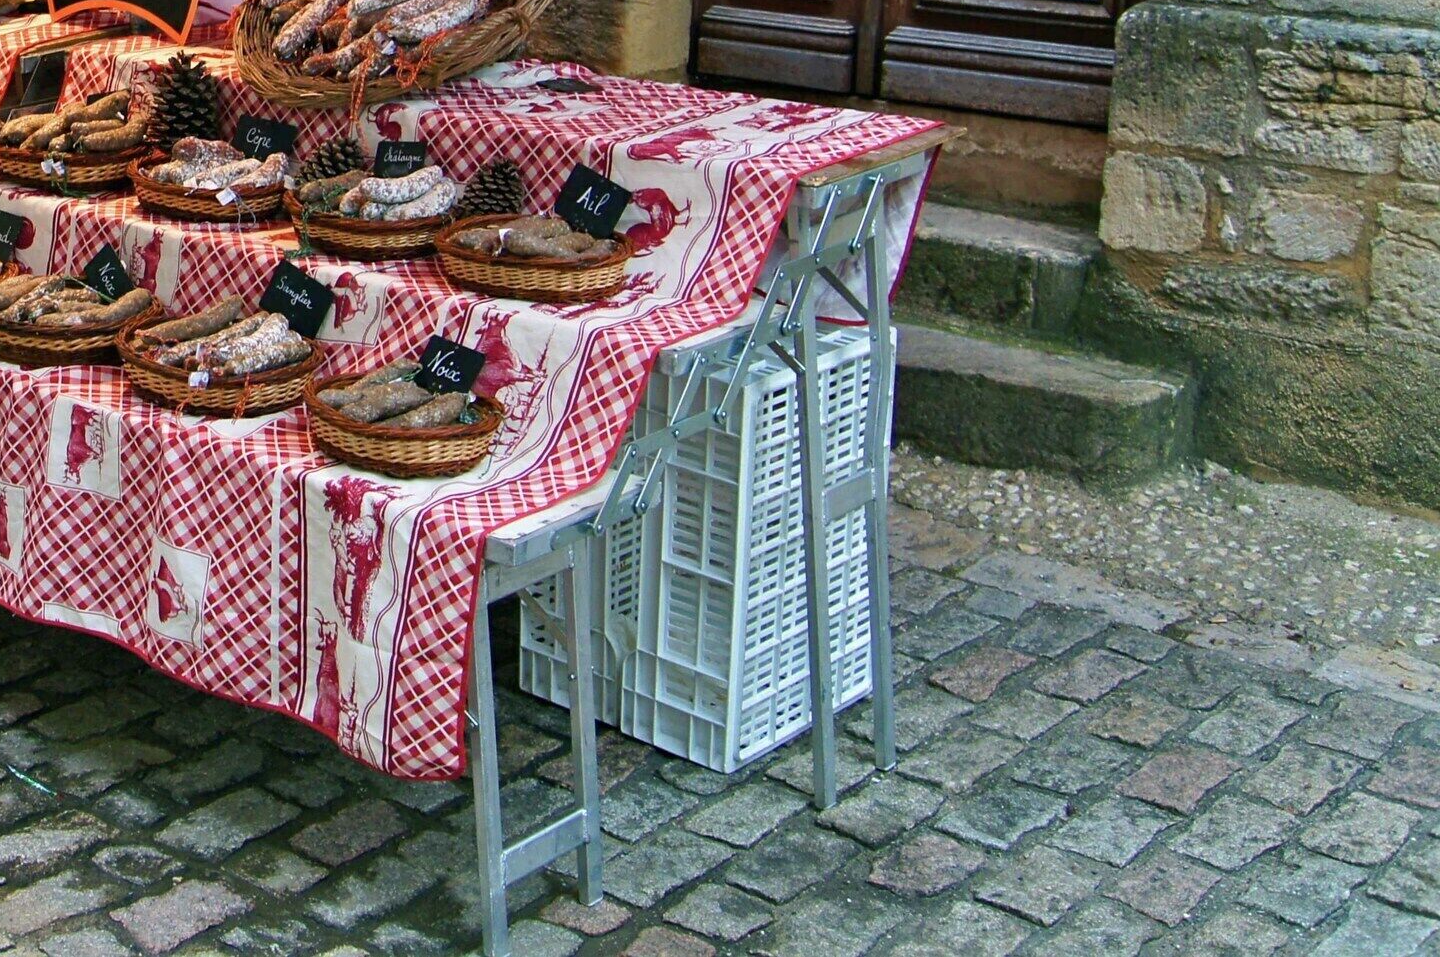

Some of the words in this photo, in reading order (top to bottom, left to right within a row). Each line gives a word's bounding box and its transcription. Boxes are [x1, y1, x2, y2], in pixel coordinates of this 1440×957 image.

[576, 186, 611, 216] Ail
[98, 262, 116, 296] Noix
[276, 275, 313, 310] Sanglier
[427, 350, 461, 383] Noix
